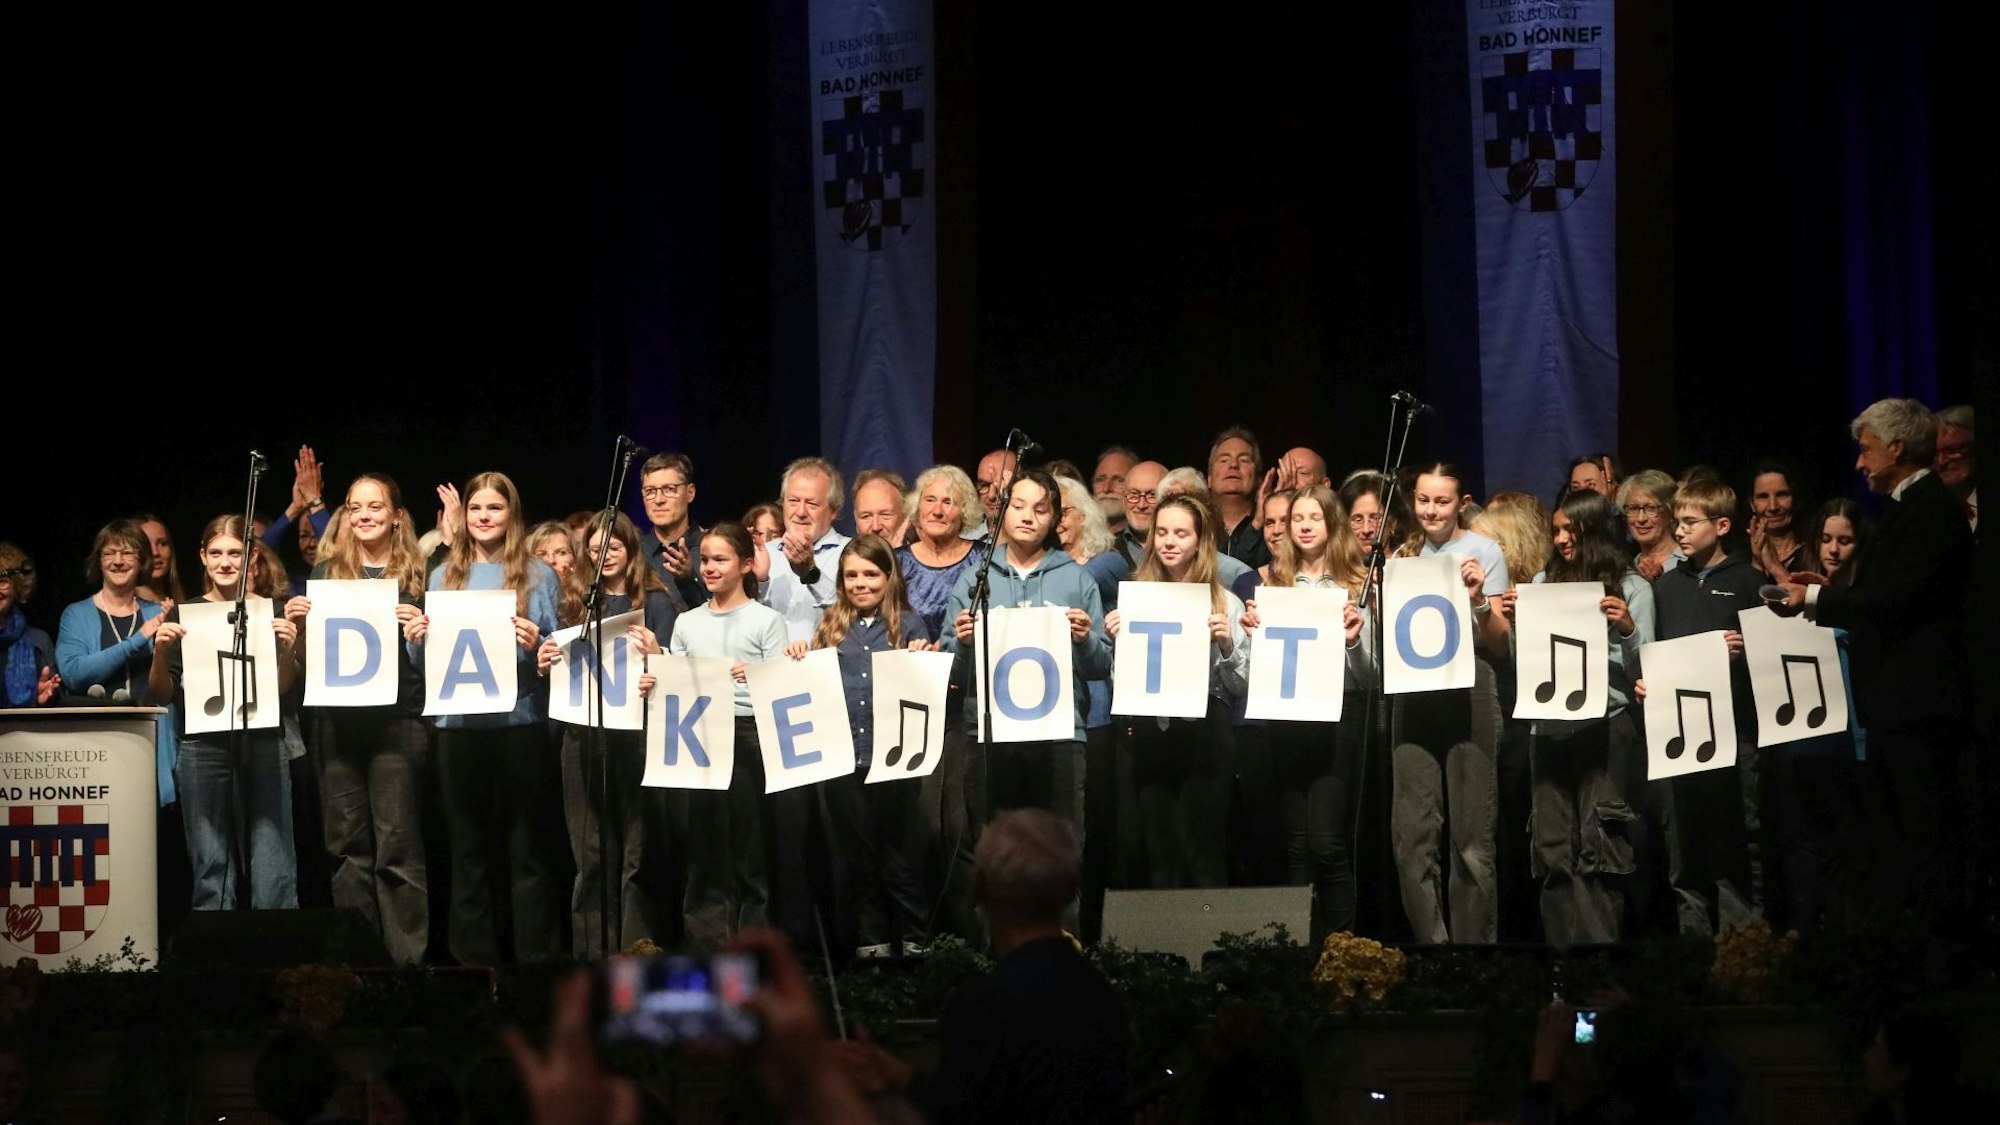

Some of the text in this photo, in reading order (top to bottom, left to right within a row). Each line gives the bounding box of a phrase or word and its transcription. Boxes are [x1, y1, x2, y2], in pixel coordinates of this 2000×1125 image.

[1497, 4, 1582, 25] VERBÜRGT
[1479, 26, 1603, 51] BAD HONNEF
[820, 66, 924, 95] BAD HONNEF
[3, 764, 90, 780] VERBÜRGT
[29, 785, 110, 800] HONNEF
